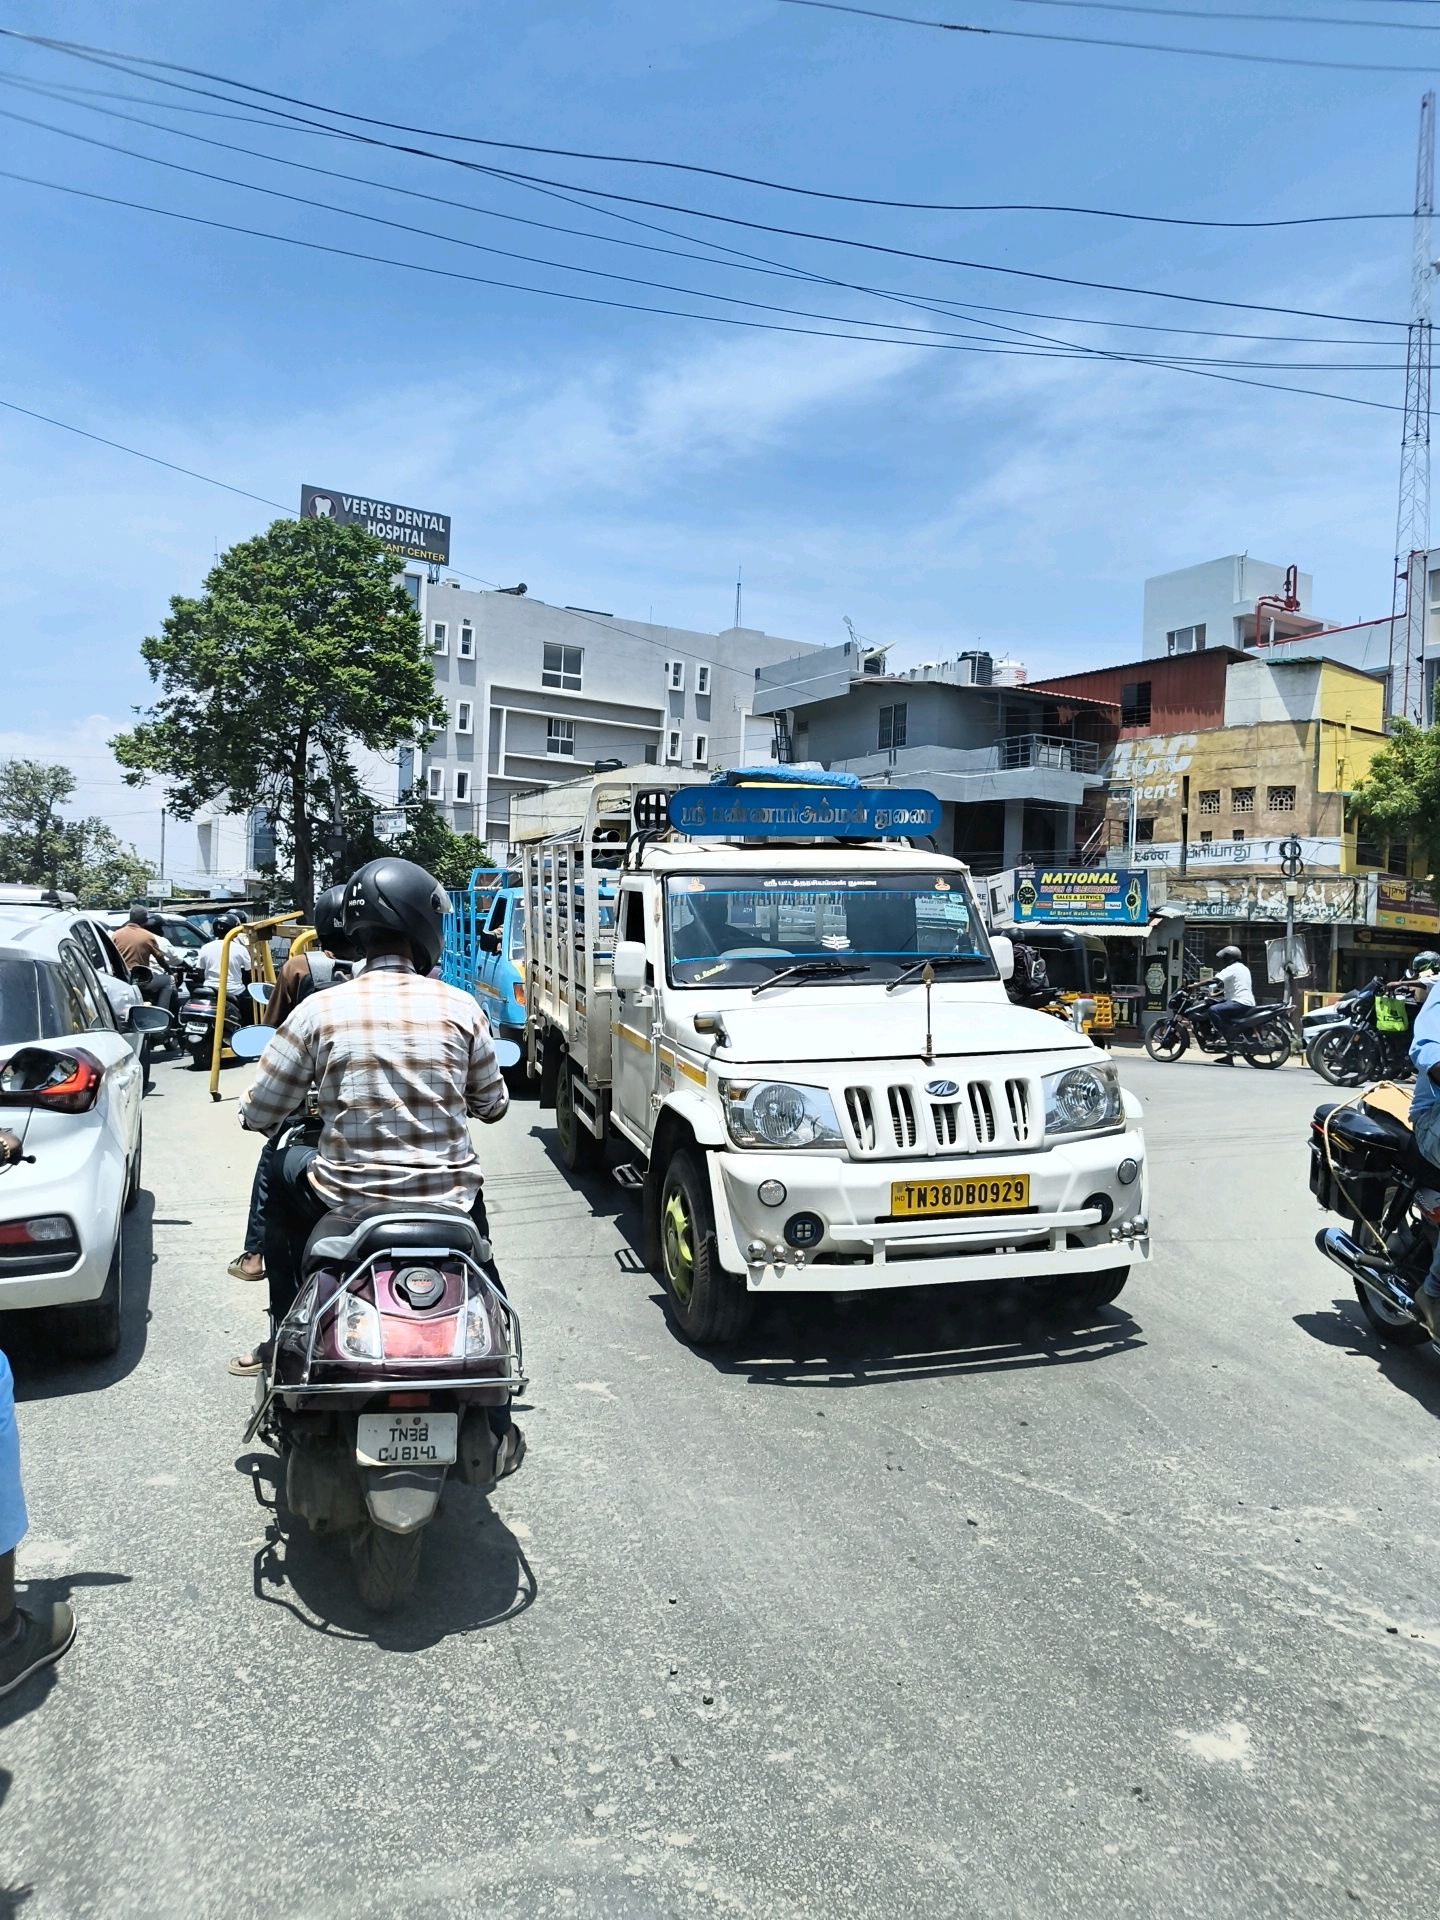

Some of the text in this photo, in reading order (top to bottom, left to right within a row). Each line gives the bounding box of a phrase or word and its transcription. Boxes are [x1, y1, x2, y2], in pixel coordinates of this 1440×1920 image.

[342, 496, 446, 533] VEEYES DENTAL
[367, 520, 426, 547] HOSPITAL
[407, 547, 446, 563] CENTER
[1112, 734, 1198, 778] ACC
[874, 808, 934, 830] துணை
[1040, 872, 1118, 884] NATIONAL
[348, 899, 366, 907] Hero
[1211, 905, 1222, 915] OF
[905, 1180, 1024, 1209] TN38DB0929
[388, 1427, 429, 1442] TN38
